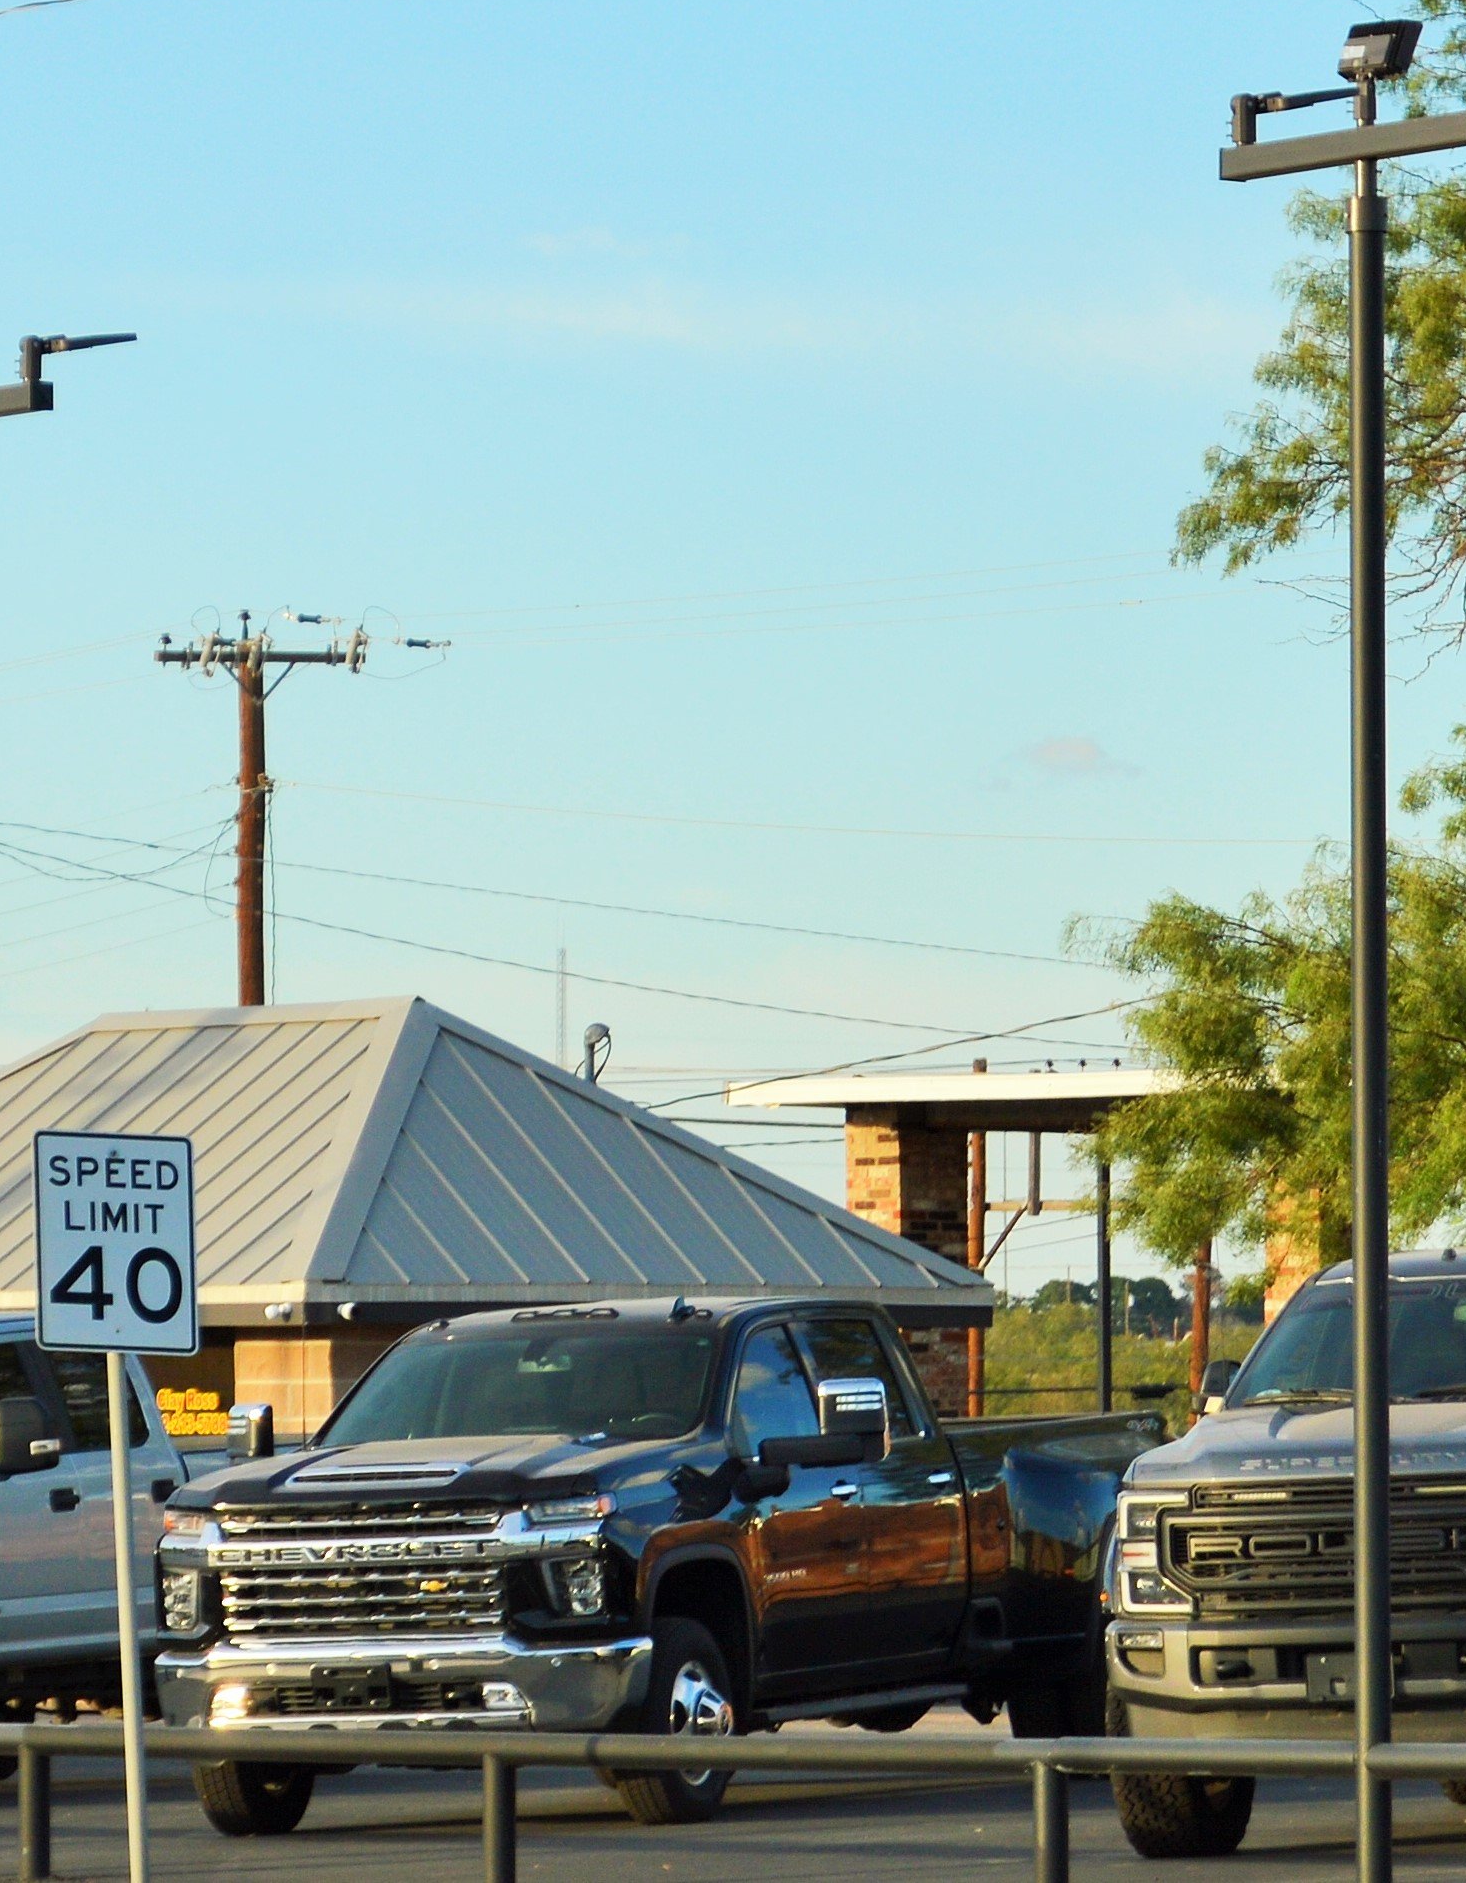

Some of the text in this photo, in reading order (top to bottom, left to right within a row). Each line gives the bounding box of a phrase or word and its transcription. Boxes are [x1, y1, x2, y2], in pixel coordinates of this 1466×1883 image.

[49, 1156, 179, 1191] SPEED
[64, 1199, 165, 1235] LIMIT
[50, 1245, 183, 1325] 40
[156, 1388, 220, 1416] Clay Ross
[216, 1539, 503, 1566] CHEVROLET
